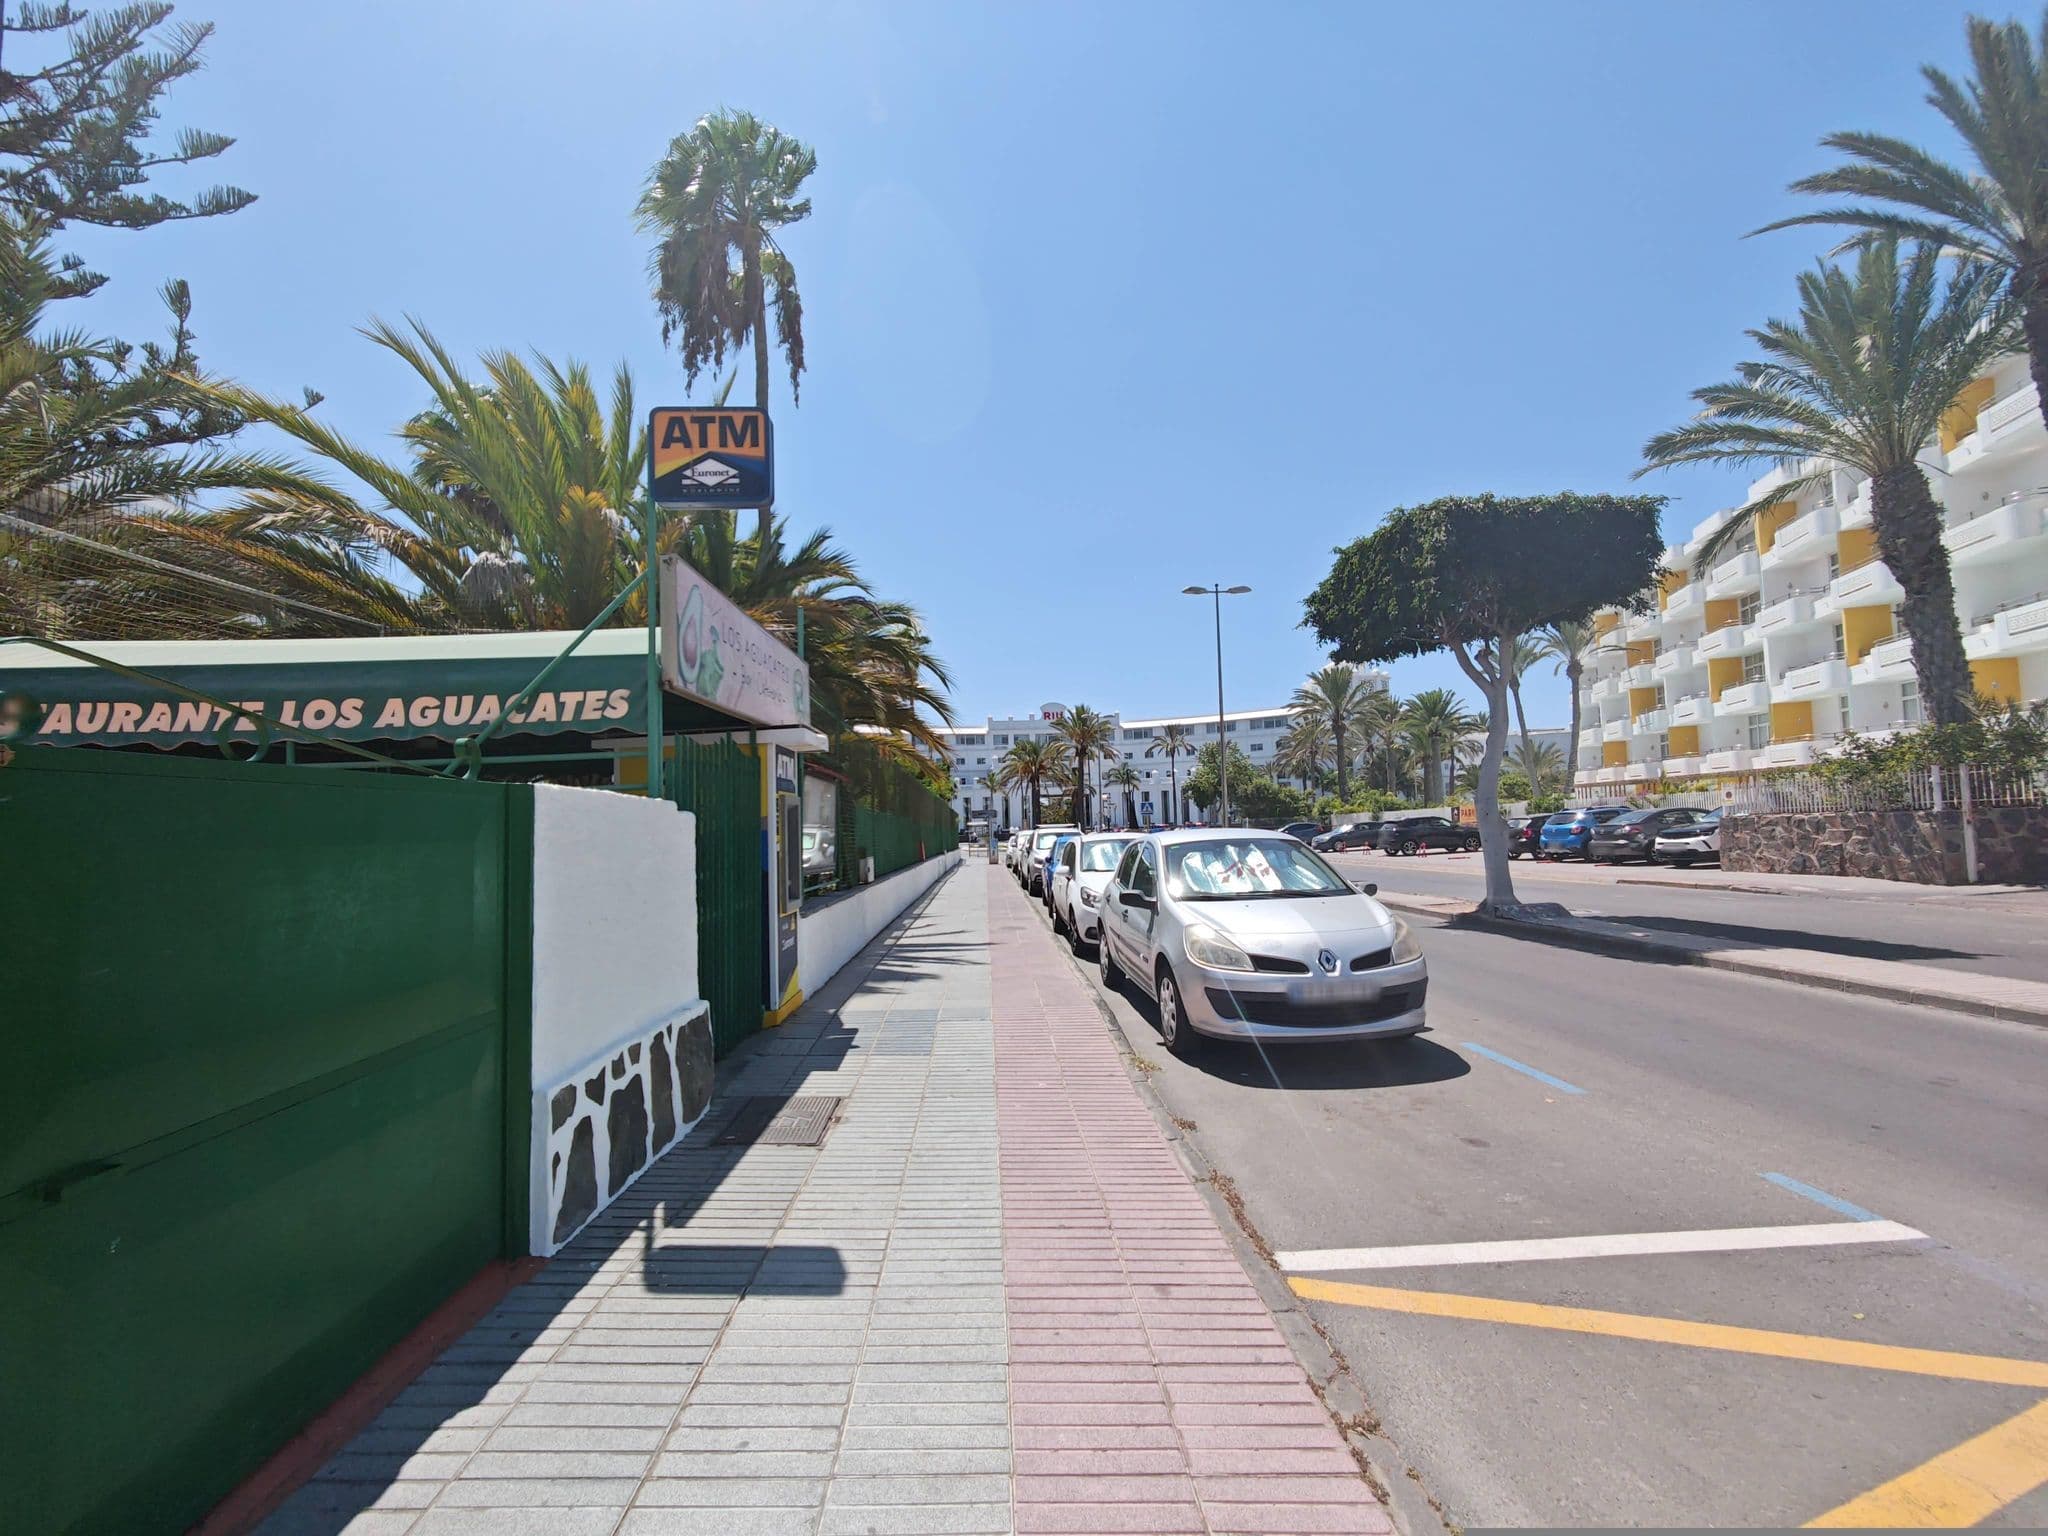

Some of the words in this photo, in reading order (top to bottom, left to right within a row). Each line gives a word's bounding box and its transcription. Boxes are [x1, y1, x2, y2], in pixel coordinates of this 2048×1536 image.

[661, 415, 760, 449] ATM
[691, 468, 730, 477] Euronet
[38, 701, 264, 735] AURANTE
[275, 697, 363, 730] LOS
[372, 688, 632, 729] AGUACATES
